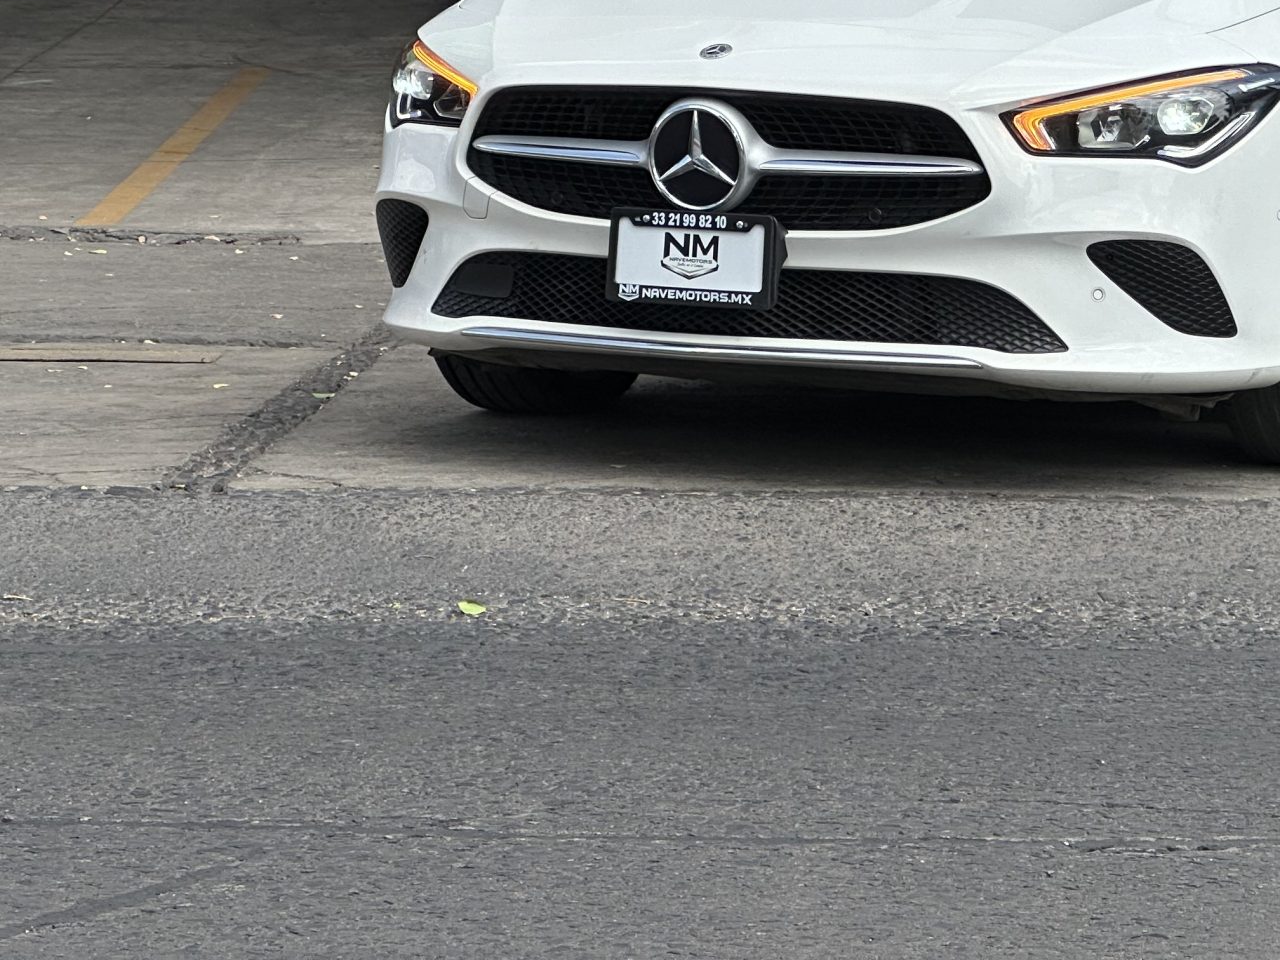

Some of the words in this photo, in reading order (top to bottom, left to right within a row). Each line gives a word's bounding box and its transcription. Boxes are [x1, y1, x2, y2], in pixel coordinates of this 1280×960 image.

[651, 211, 666, 225] 33
[668, 213, 680, 226] 21
[682, 214, 696, 227] 99
[698, 214, 712, 228] 82
[714, 215, 727, 229] 10
[663, 231, 720, 263] NM
[669, 256, 713, 265] NAVEMOTORS
[618, 283, 640, 295] NM
[641, 287, 753, 305] NAVEMOTORS.MX
